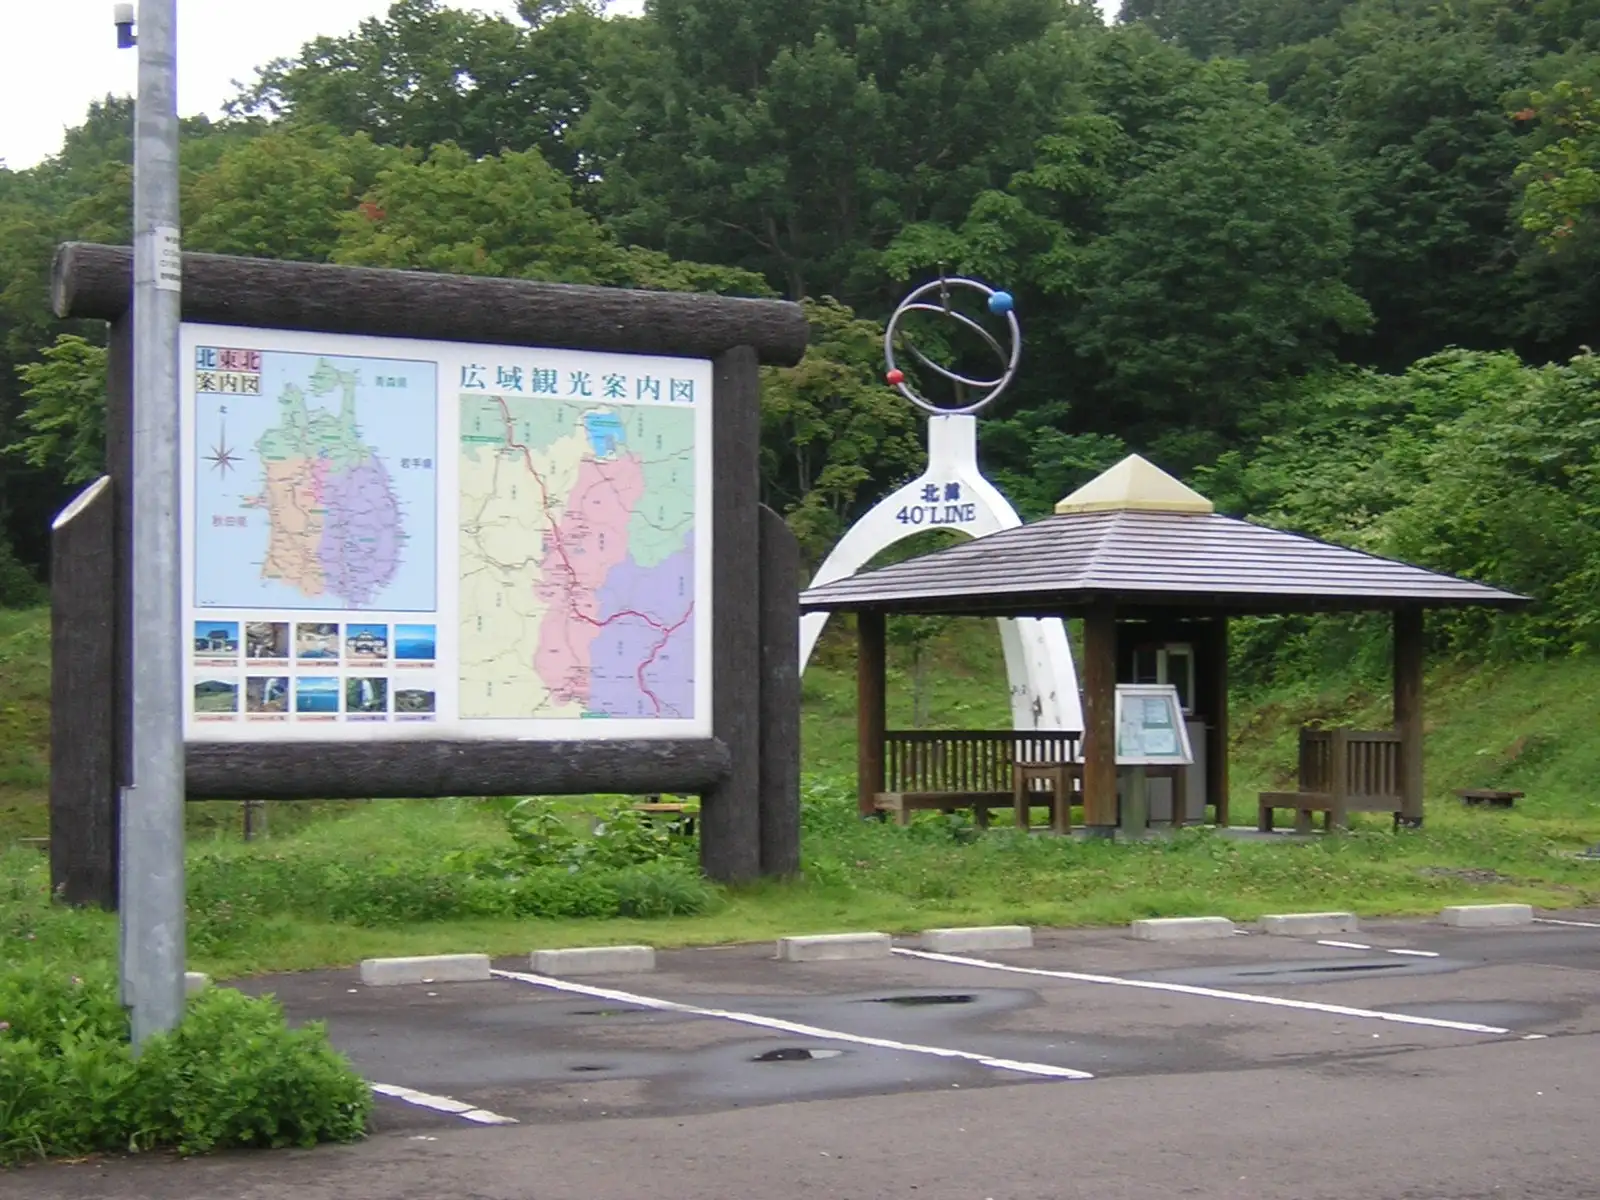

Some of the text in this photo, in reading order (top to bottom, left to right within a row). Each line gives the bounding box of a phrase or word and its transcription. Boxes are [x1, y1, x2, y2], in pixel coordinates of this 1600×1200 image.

[196, 350, 260, 371] 北東北
[196, 373, 260, 393] 案内図
[460, 364, 695, 402] 広域観光案内図
